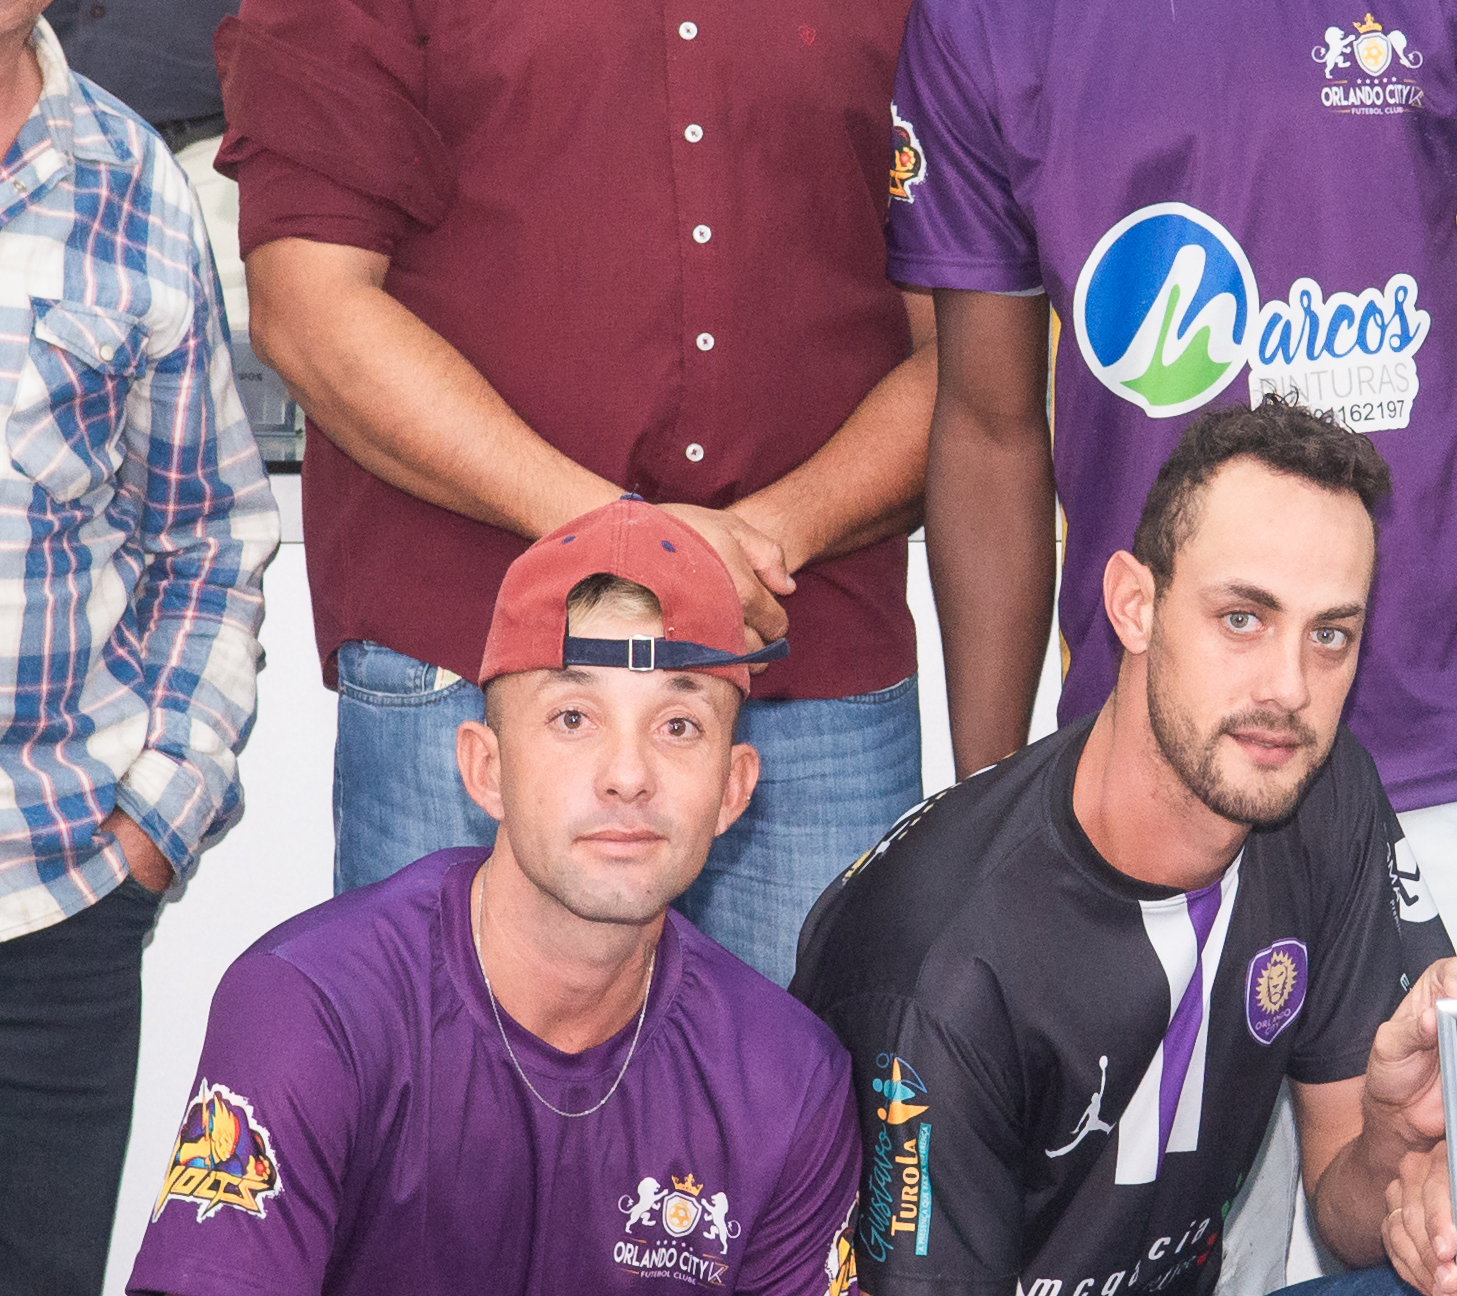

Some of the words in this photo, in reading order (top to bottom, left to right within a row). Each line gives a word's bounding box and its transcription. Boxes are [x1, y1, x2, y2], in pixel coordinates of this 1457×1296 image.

[1321, 85, 1383, 106] ORLANDO
[1385, 84, 1411, 105] CITY
[1351, 107, 1383, 115] FUTEBOL
[153, 1163, 270, 1221] VOLTS
[859, 1122, 894, 1263] Gustavo
[891, 1138, 920, 1236] TUROLA
[920, 1192, 929, 1208] QUE
[613, 1241, 677, 1268] ORLANDO
[679, 1251, 709, 1280] CITY
[641, 1270, 670, 1278] FUTEBOL
